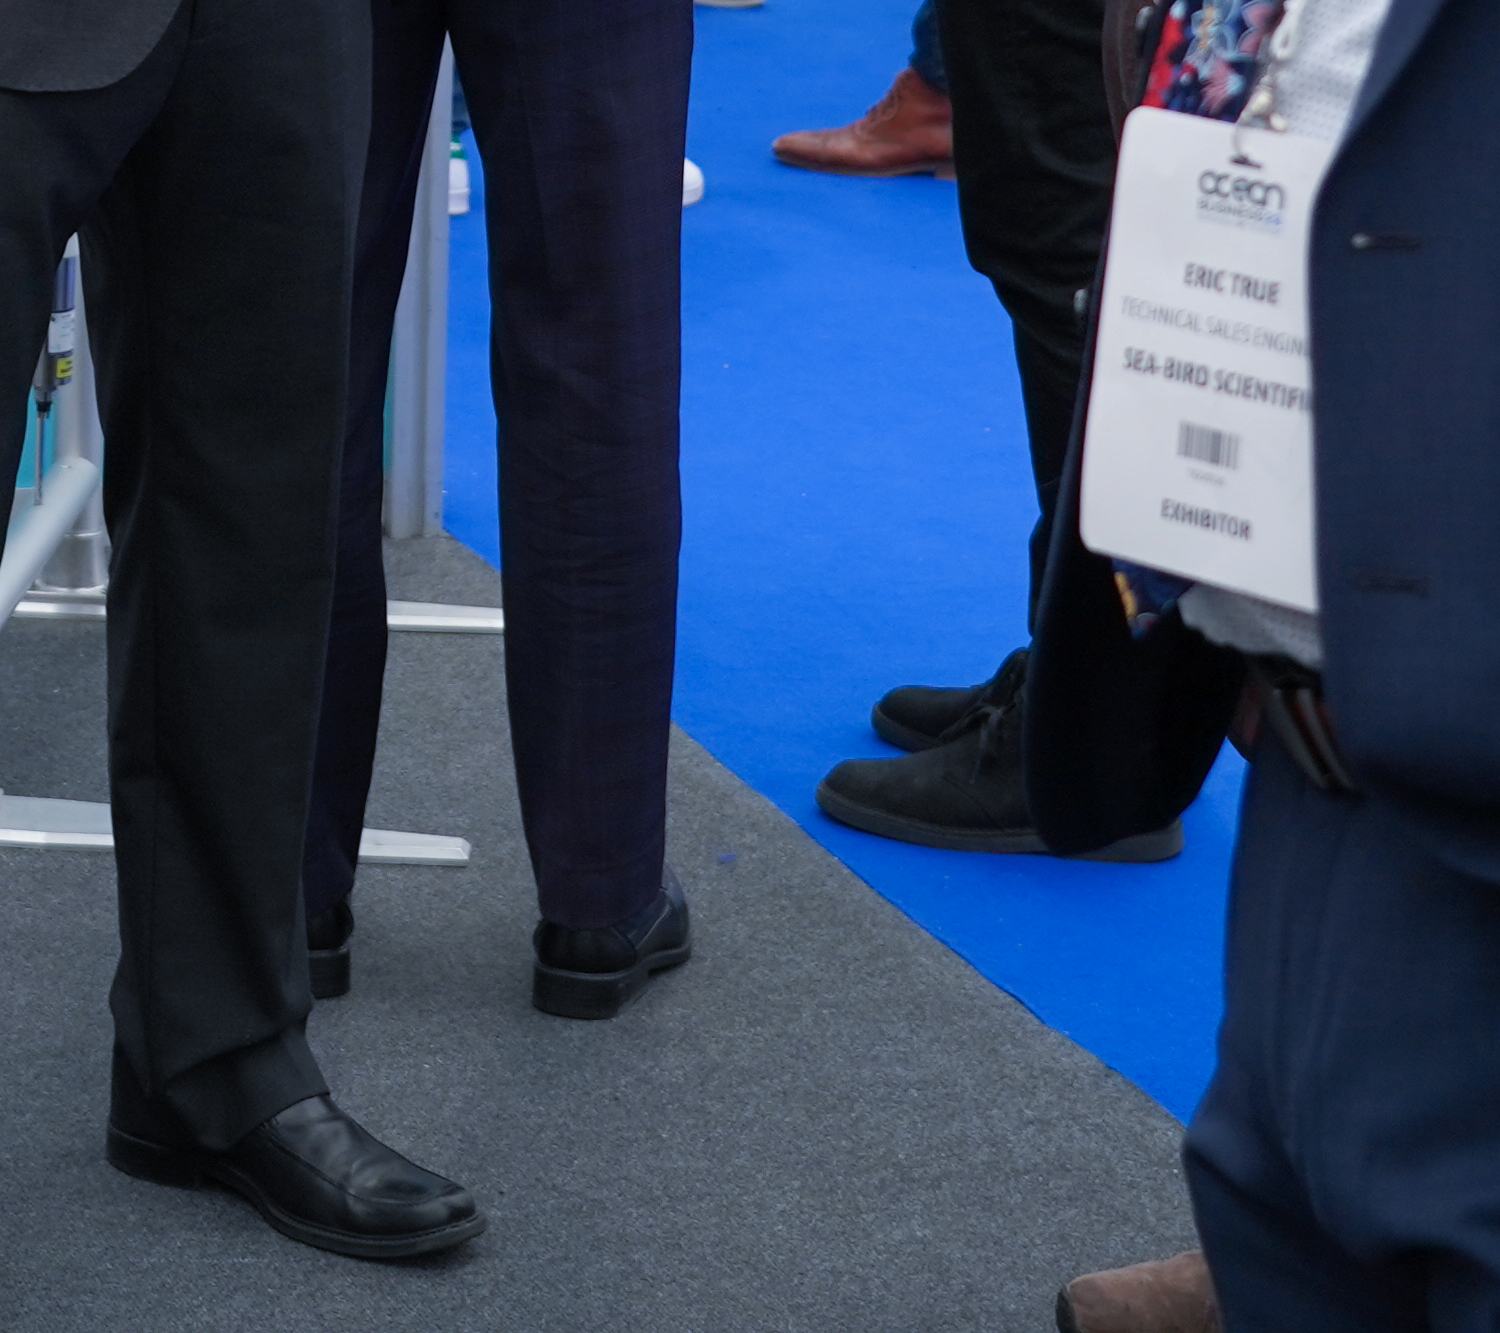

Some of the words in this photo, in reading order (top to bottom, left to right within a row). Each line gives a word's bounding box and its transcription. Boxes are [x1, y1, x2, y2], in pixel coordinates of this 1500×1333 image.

[1198, 169, 1286, 210] ocean
[1183, 262, 1225, 293] ERIC
[1230, 271, 1280, 305] TRUE
[1120, 295, 1202, 333] TECHNICAL
[1251, 326, 1310, 359] ENGIN
[1122, 346, 1210, 387] SEA-BIRD
[1213, 368, 1311, 412] SCIENTIFI
[1160, 497, 1253, 542] EXHIBITOR
